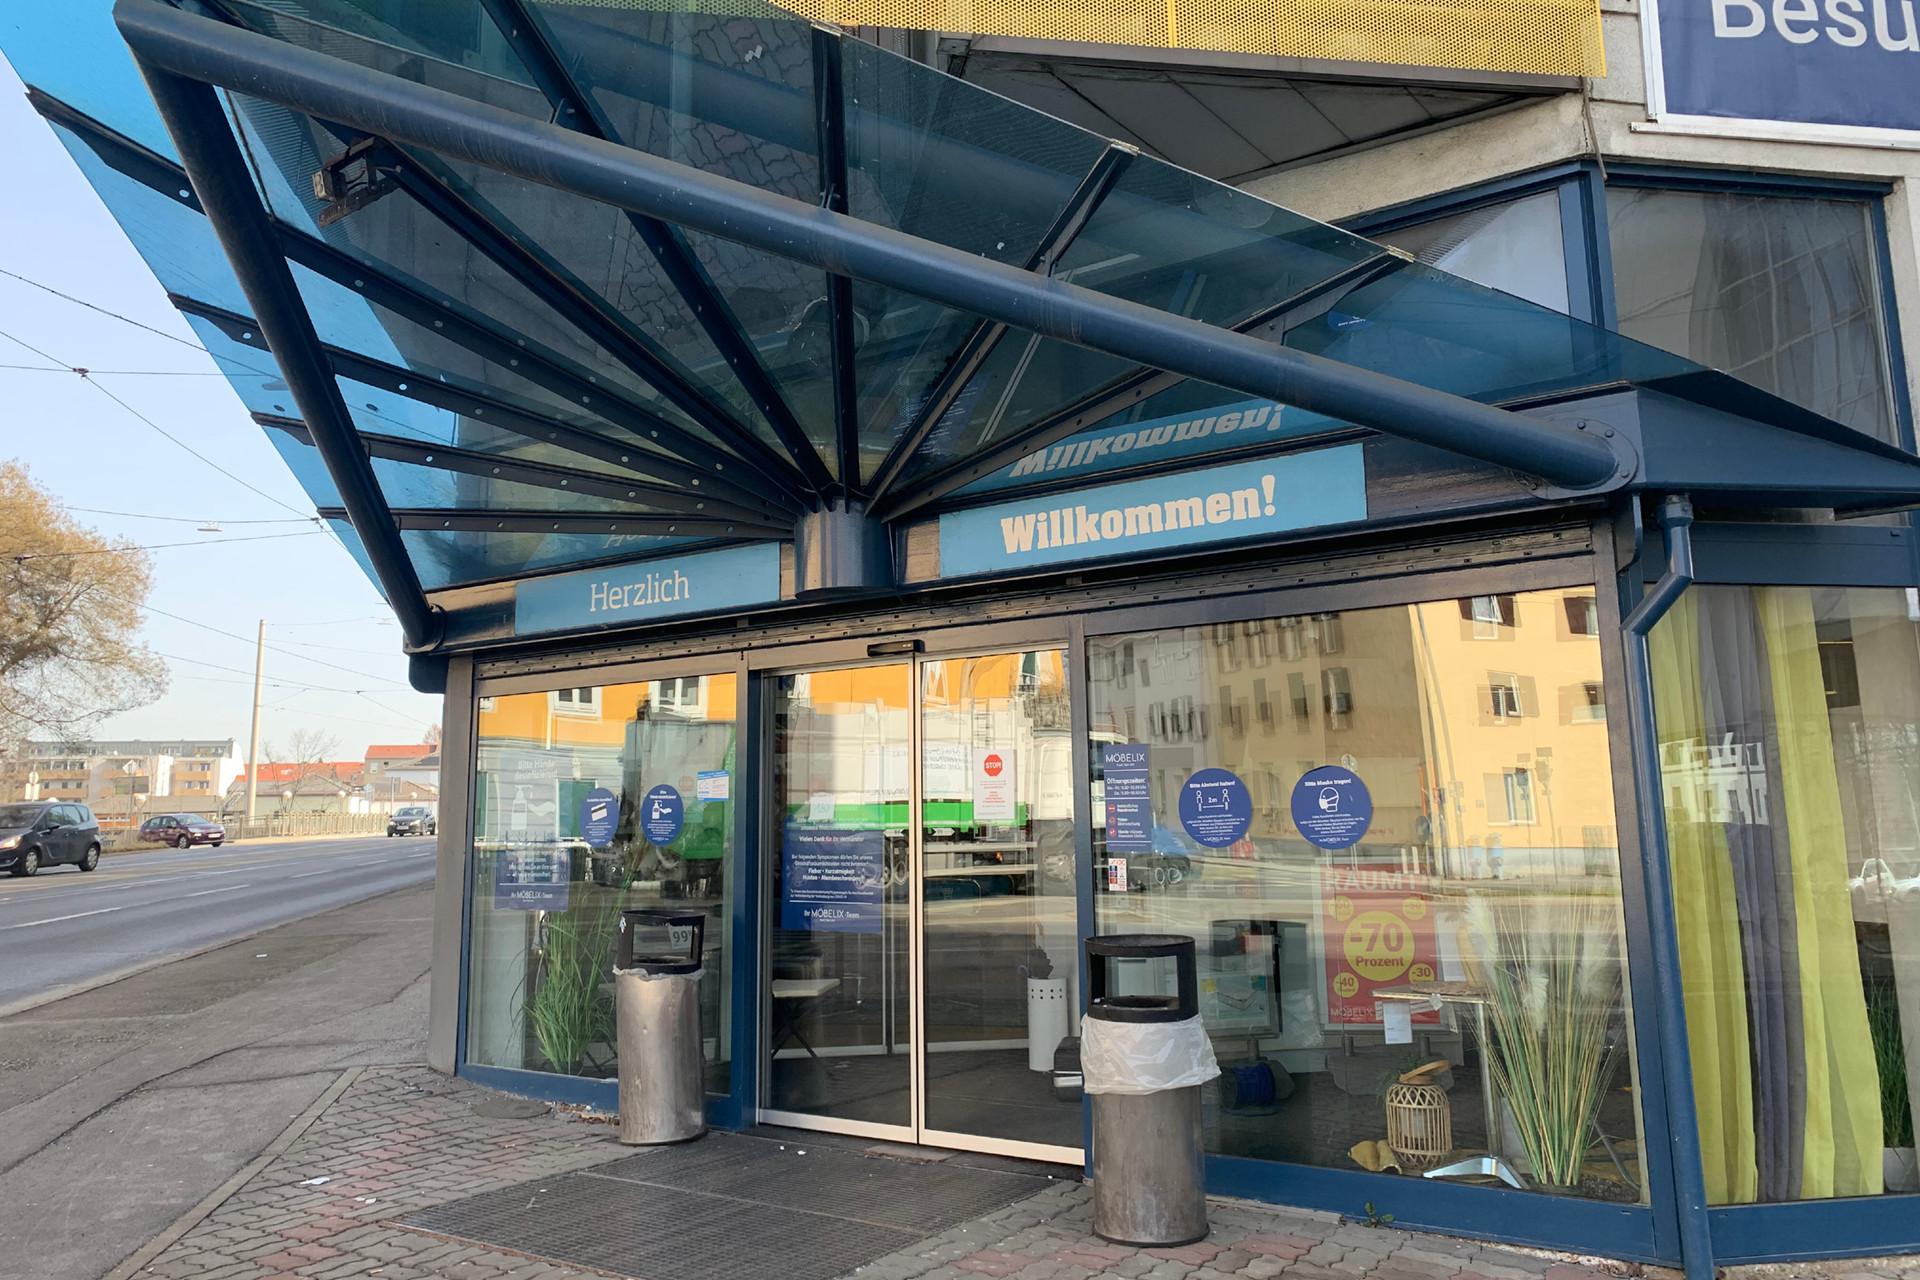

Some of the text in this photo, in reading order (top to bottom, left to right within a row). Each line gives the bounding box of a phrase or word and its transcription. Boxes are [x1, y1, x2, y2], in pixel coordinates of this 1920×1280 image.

[1000, 474, 1277, 555] Willkommen!
[589, 569, 690, 613] Herzlich
[1105, 752, 1145, 763] MÖBELIX
[1350, 923, 1404, 952] -70
[1356, 955, 1404, 967] Prozent
[1412, 967, 1431, 977] -30
